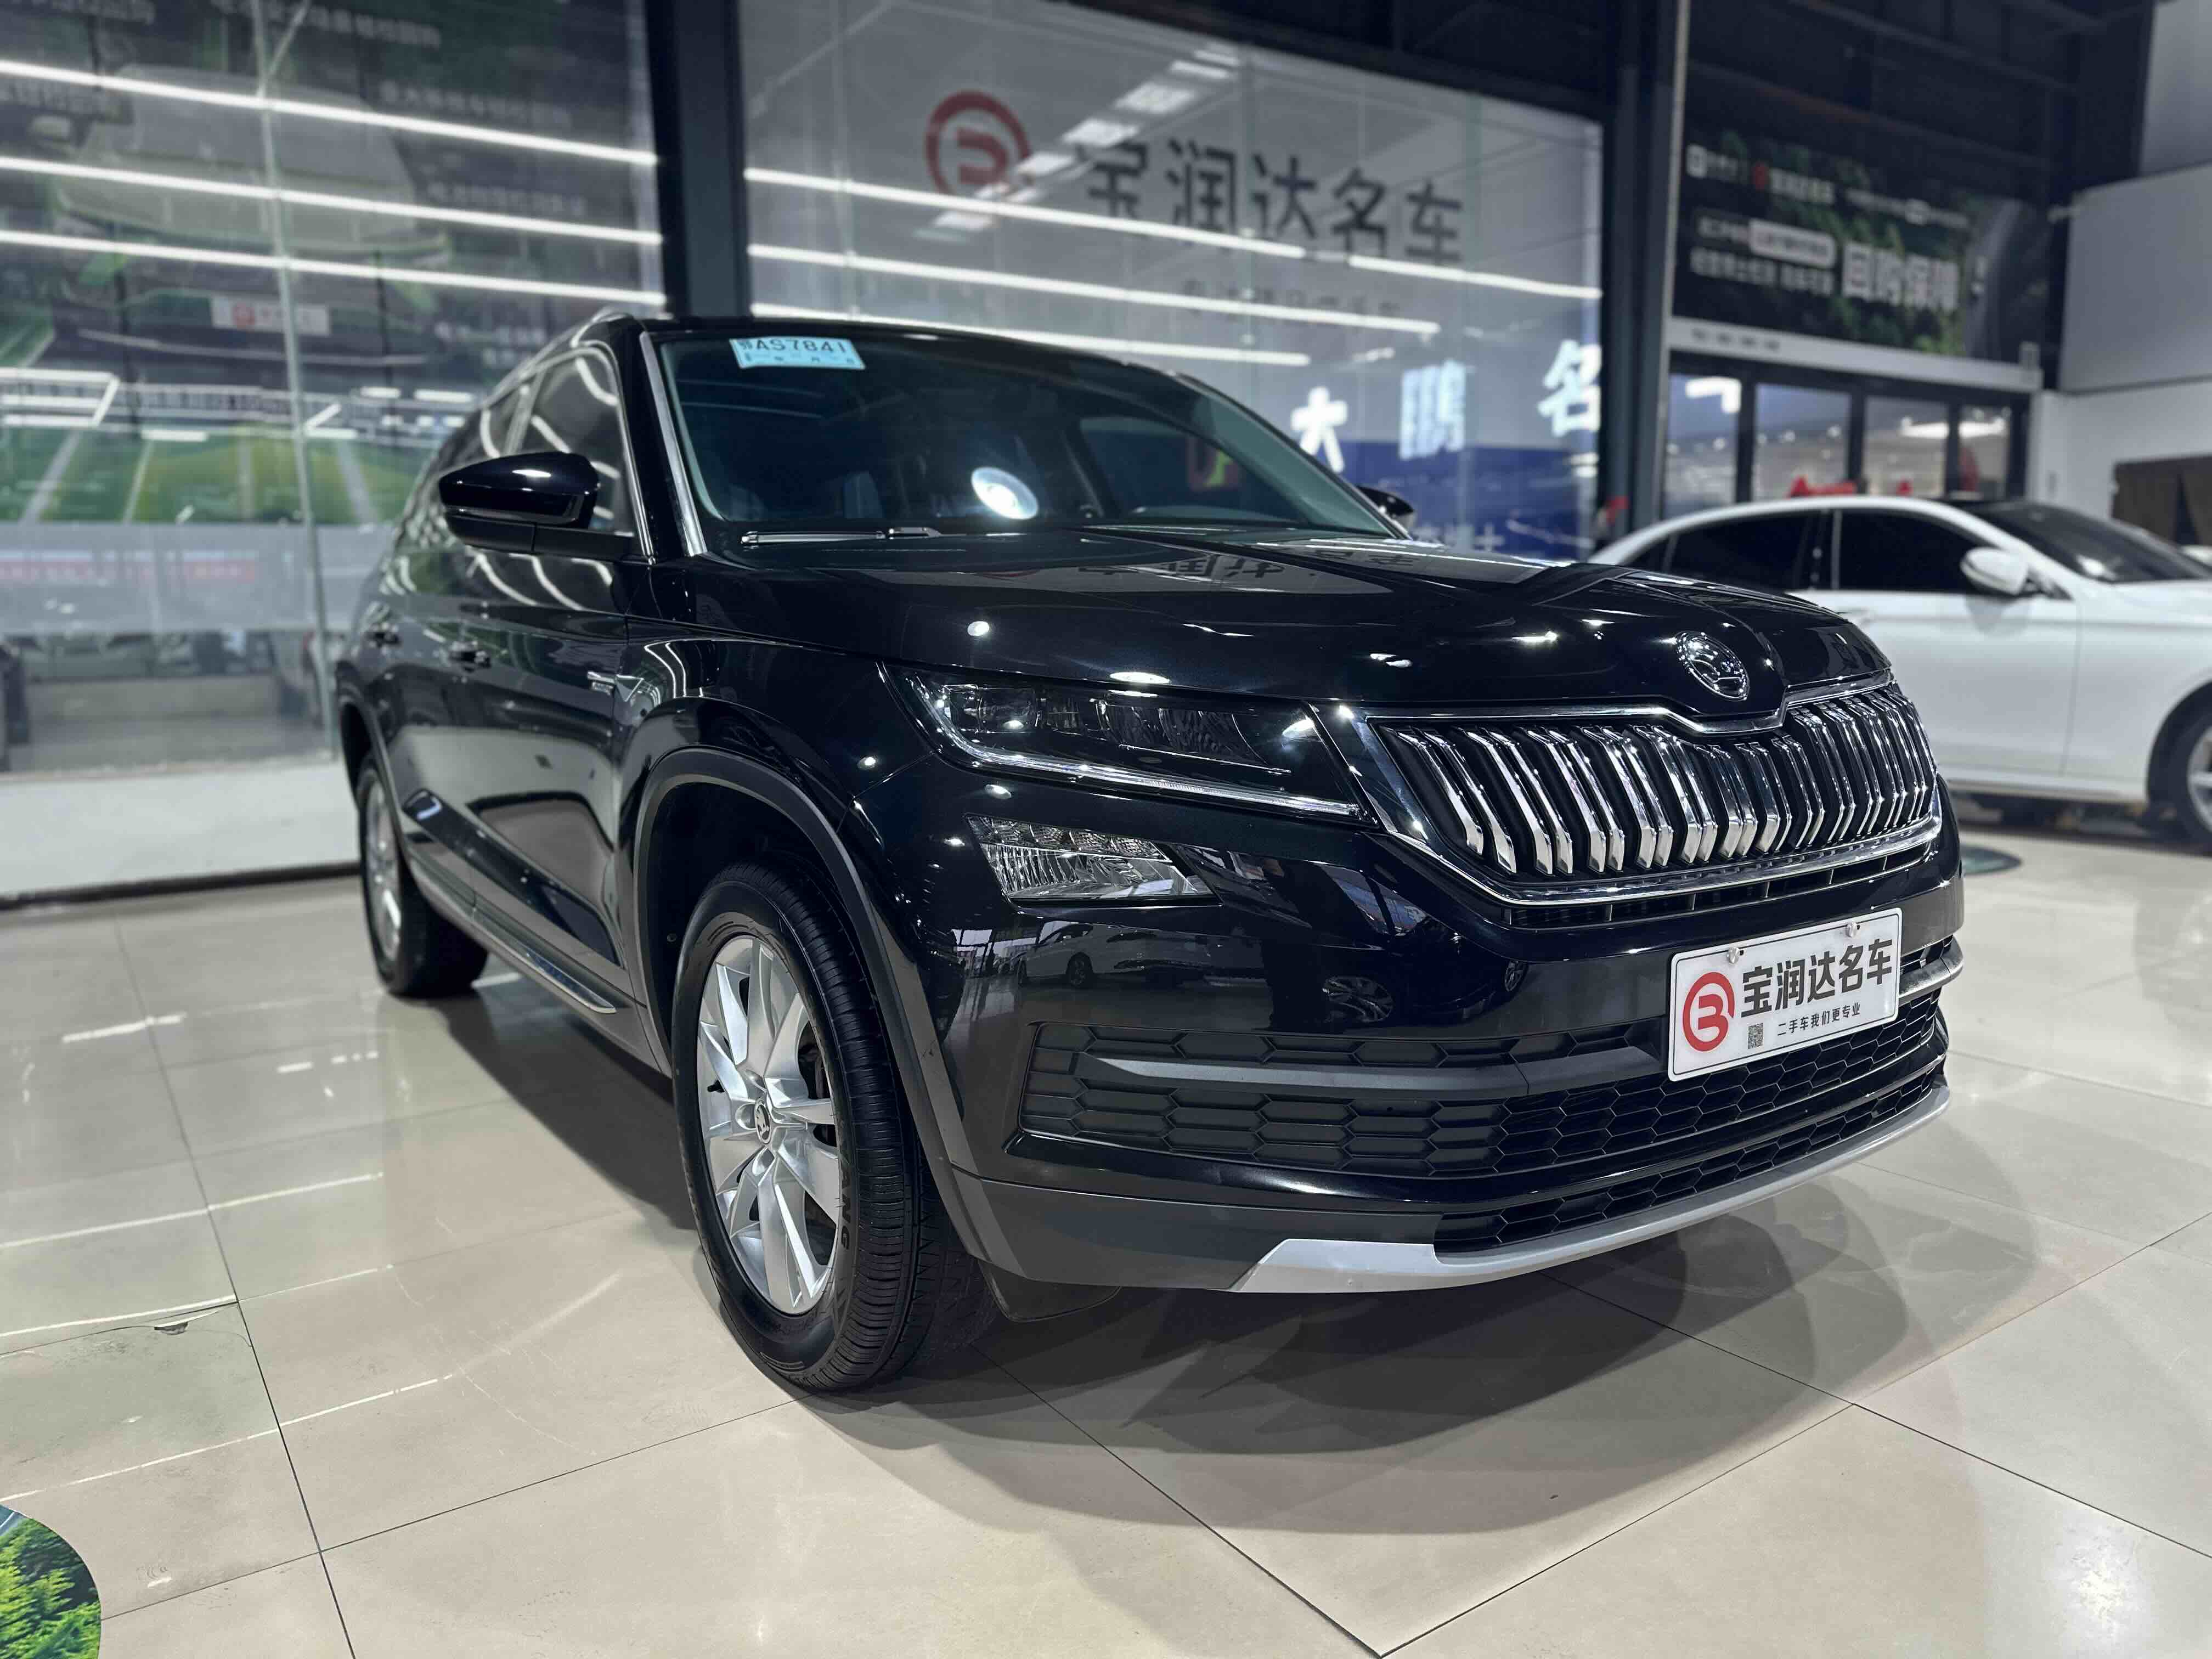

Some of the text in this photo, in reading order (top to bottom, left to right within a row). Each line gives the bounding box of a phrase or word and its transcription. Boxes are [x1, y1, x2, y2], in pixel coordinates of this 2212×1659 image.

[1741, 939, 1892, 1018] 宝润达名车
[1778, 1002, 1860, 1036] 二手车我们更专业
